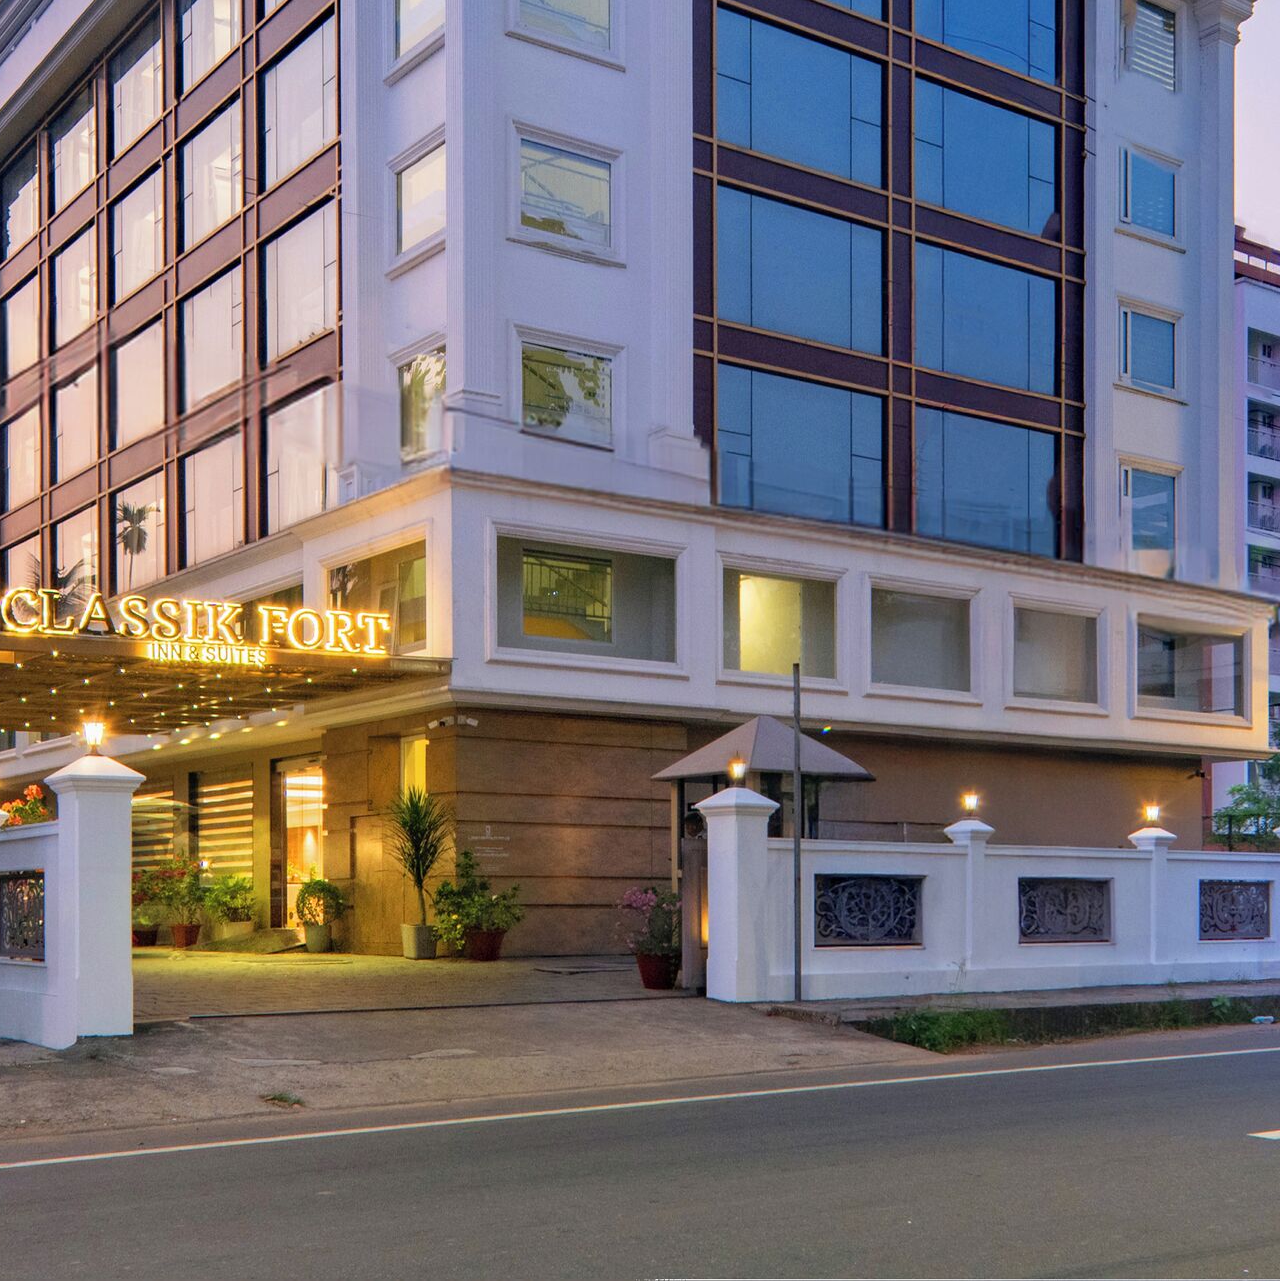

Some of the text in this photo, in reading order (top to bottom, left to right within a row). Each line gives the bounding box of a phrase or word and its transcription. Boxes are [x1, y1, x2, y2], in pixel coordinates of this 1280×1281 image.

[0, 587, 391, 655] CLASSIK FORT
[153, 642, 268, 664] INN & SUITES
